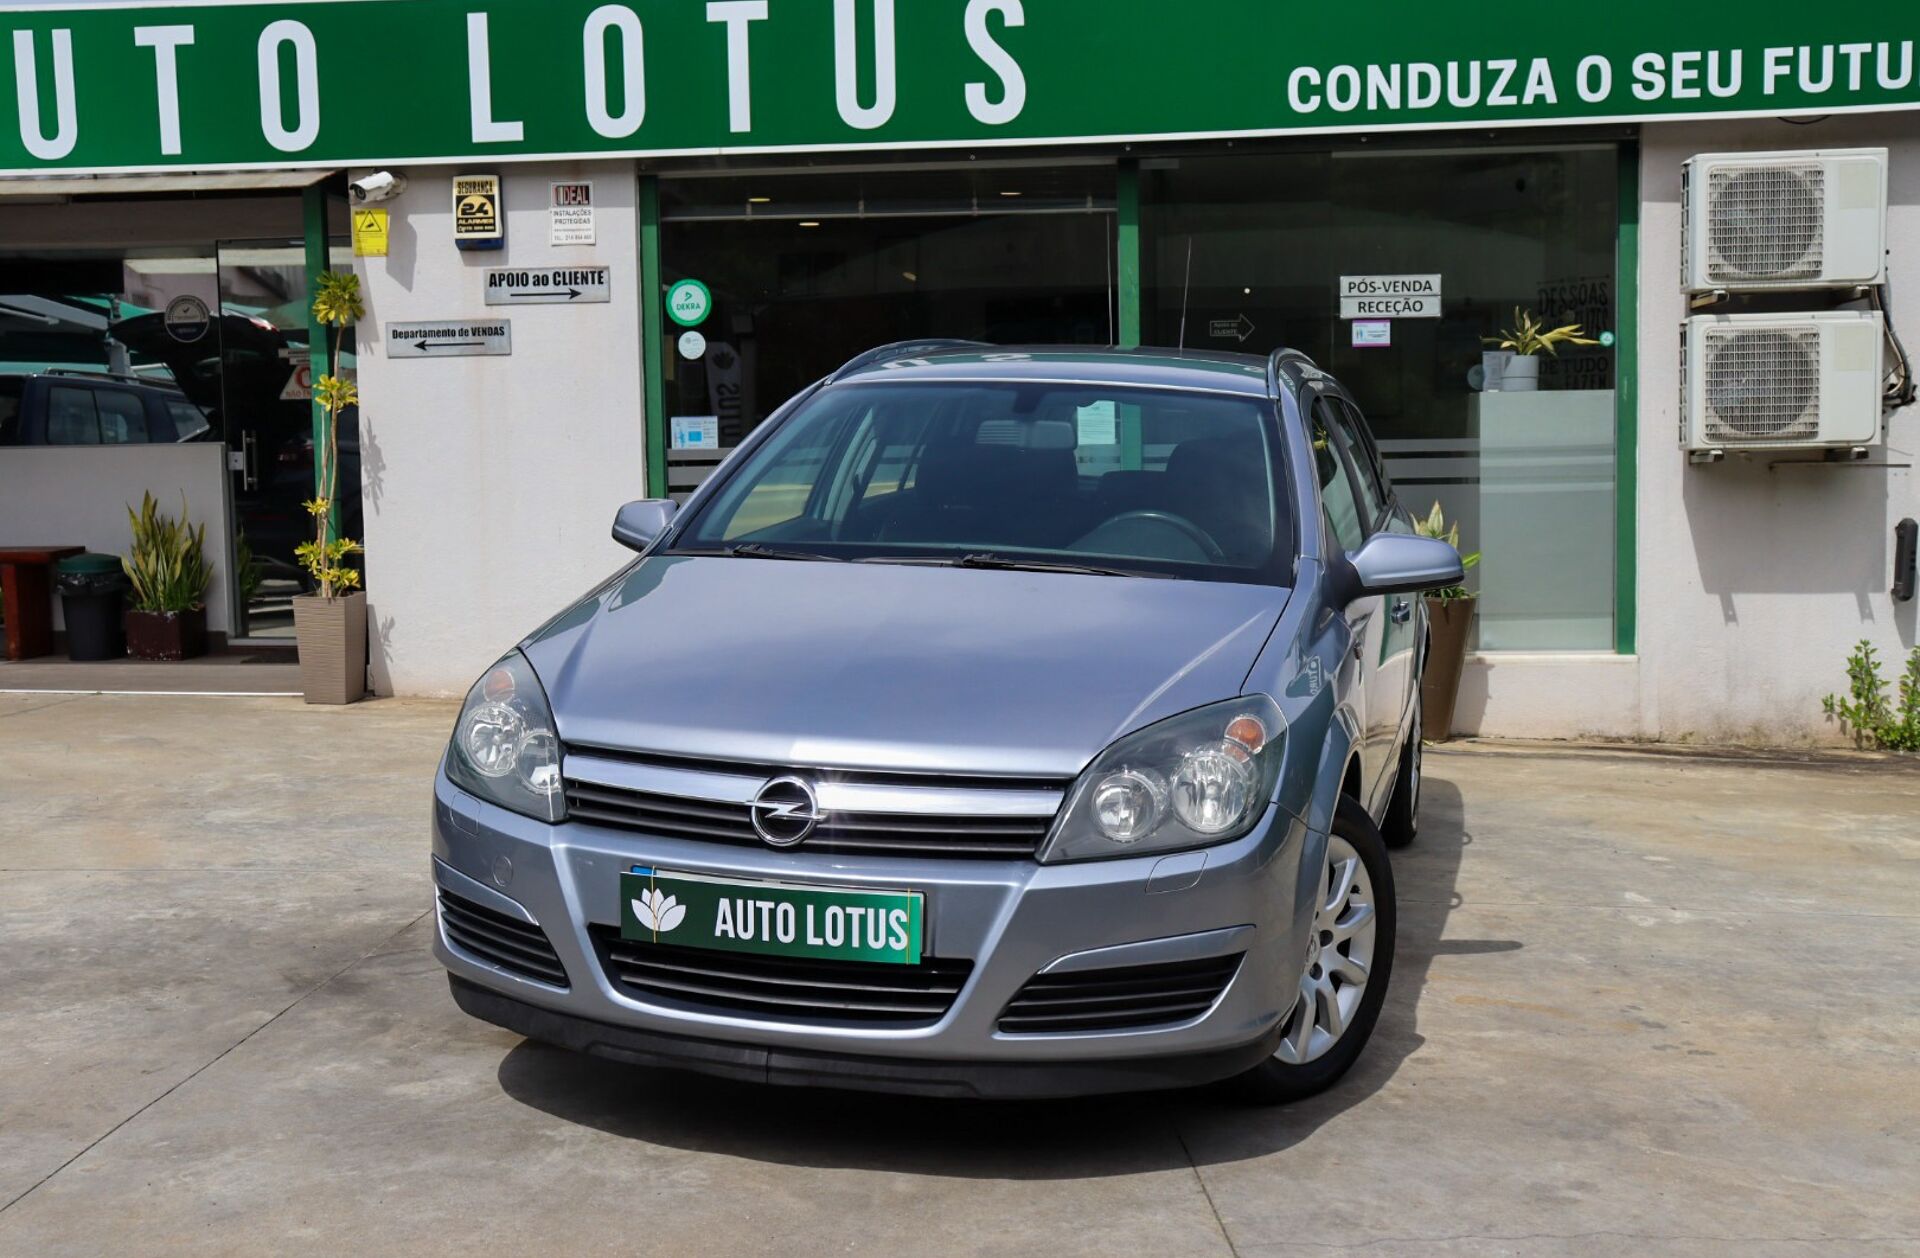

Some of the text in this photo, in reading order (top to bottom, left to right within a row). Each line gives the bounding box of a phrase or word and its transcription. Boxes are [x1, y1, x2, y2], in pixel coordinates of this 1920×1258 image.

[466, 0, 1026, 143] LOTUS
[1287, 40, 1920, 113] CONDUZA O SEU FUTU
[460, 202, 489, 216] 24
[489, 270, 604, 288] APOIO ao CLIENTE
[1348, 279, 1433, 294] PÓS-VENDA
[676, 302, 701, 311] DEKRA
[1358, 298, 1424, 315] RECEÇÃO
[392, 326, 505, 340] Departamento de VENDAS
[715, 898, 908, 951] AUTO LOTUS
